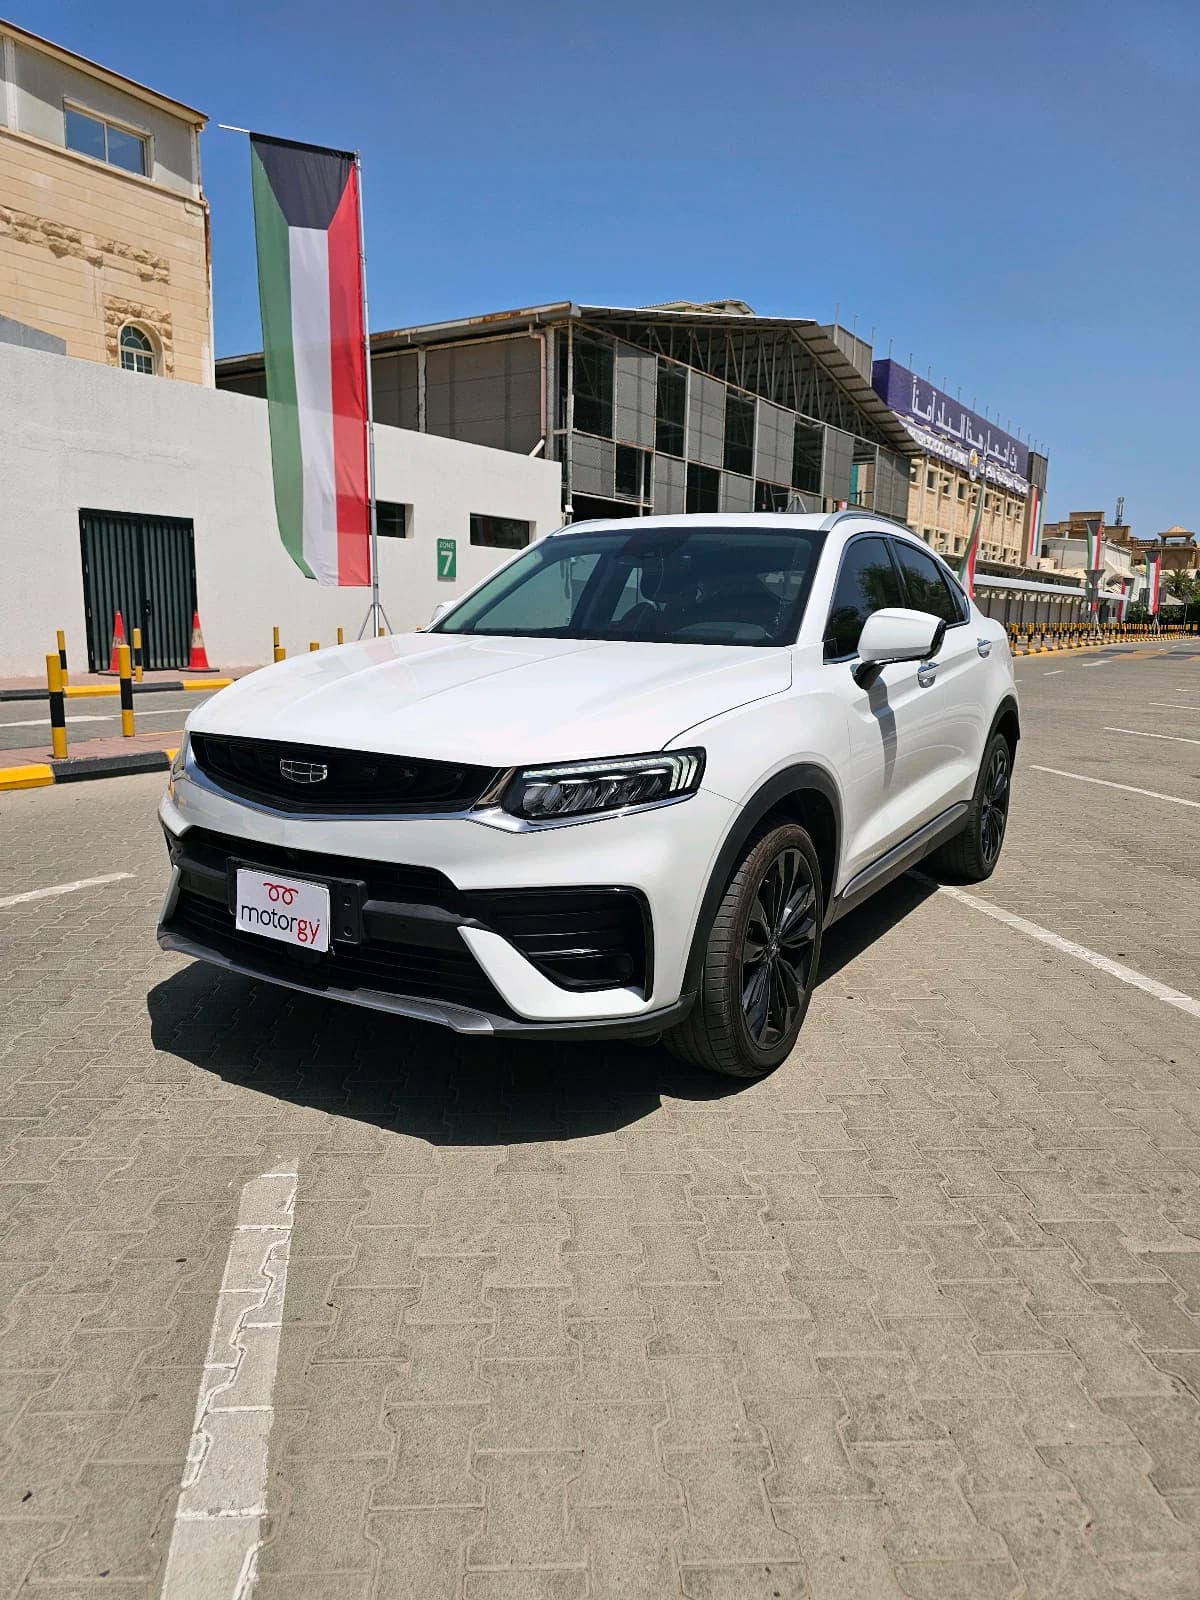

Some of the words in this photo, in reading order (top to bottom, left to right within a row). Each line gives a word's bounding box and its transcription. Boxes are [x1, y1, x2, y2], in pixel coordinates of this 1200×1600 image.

[936, 402, 966, 440] البلد
[966, 417, 983, 449] هذا
[440, 550, 453, 575] 7
[241, 904, 320, 945] motorgy
